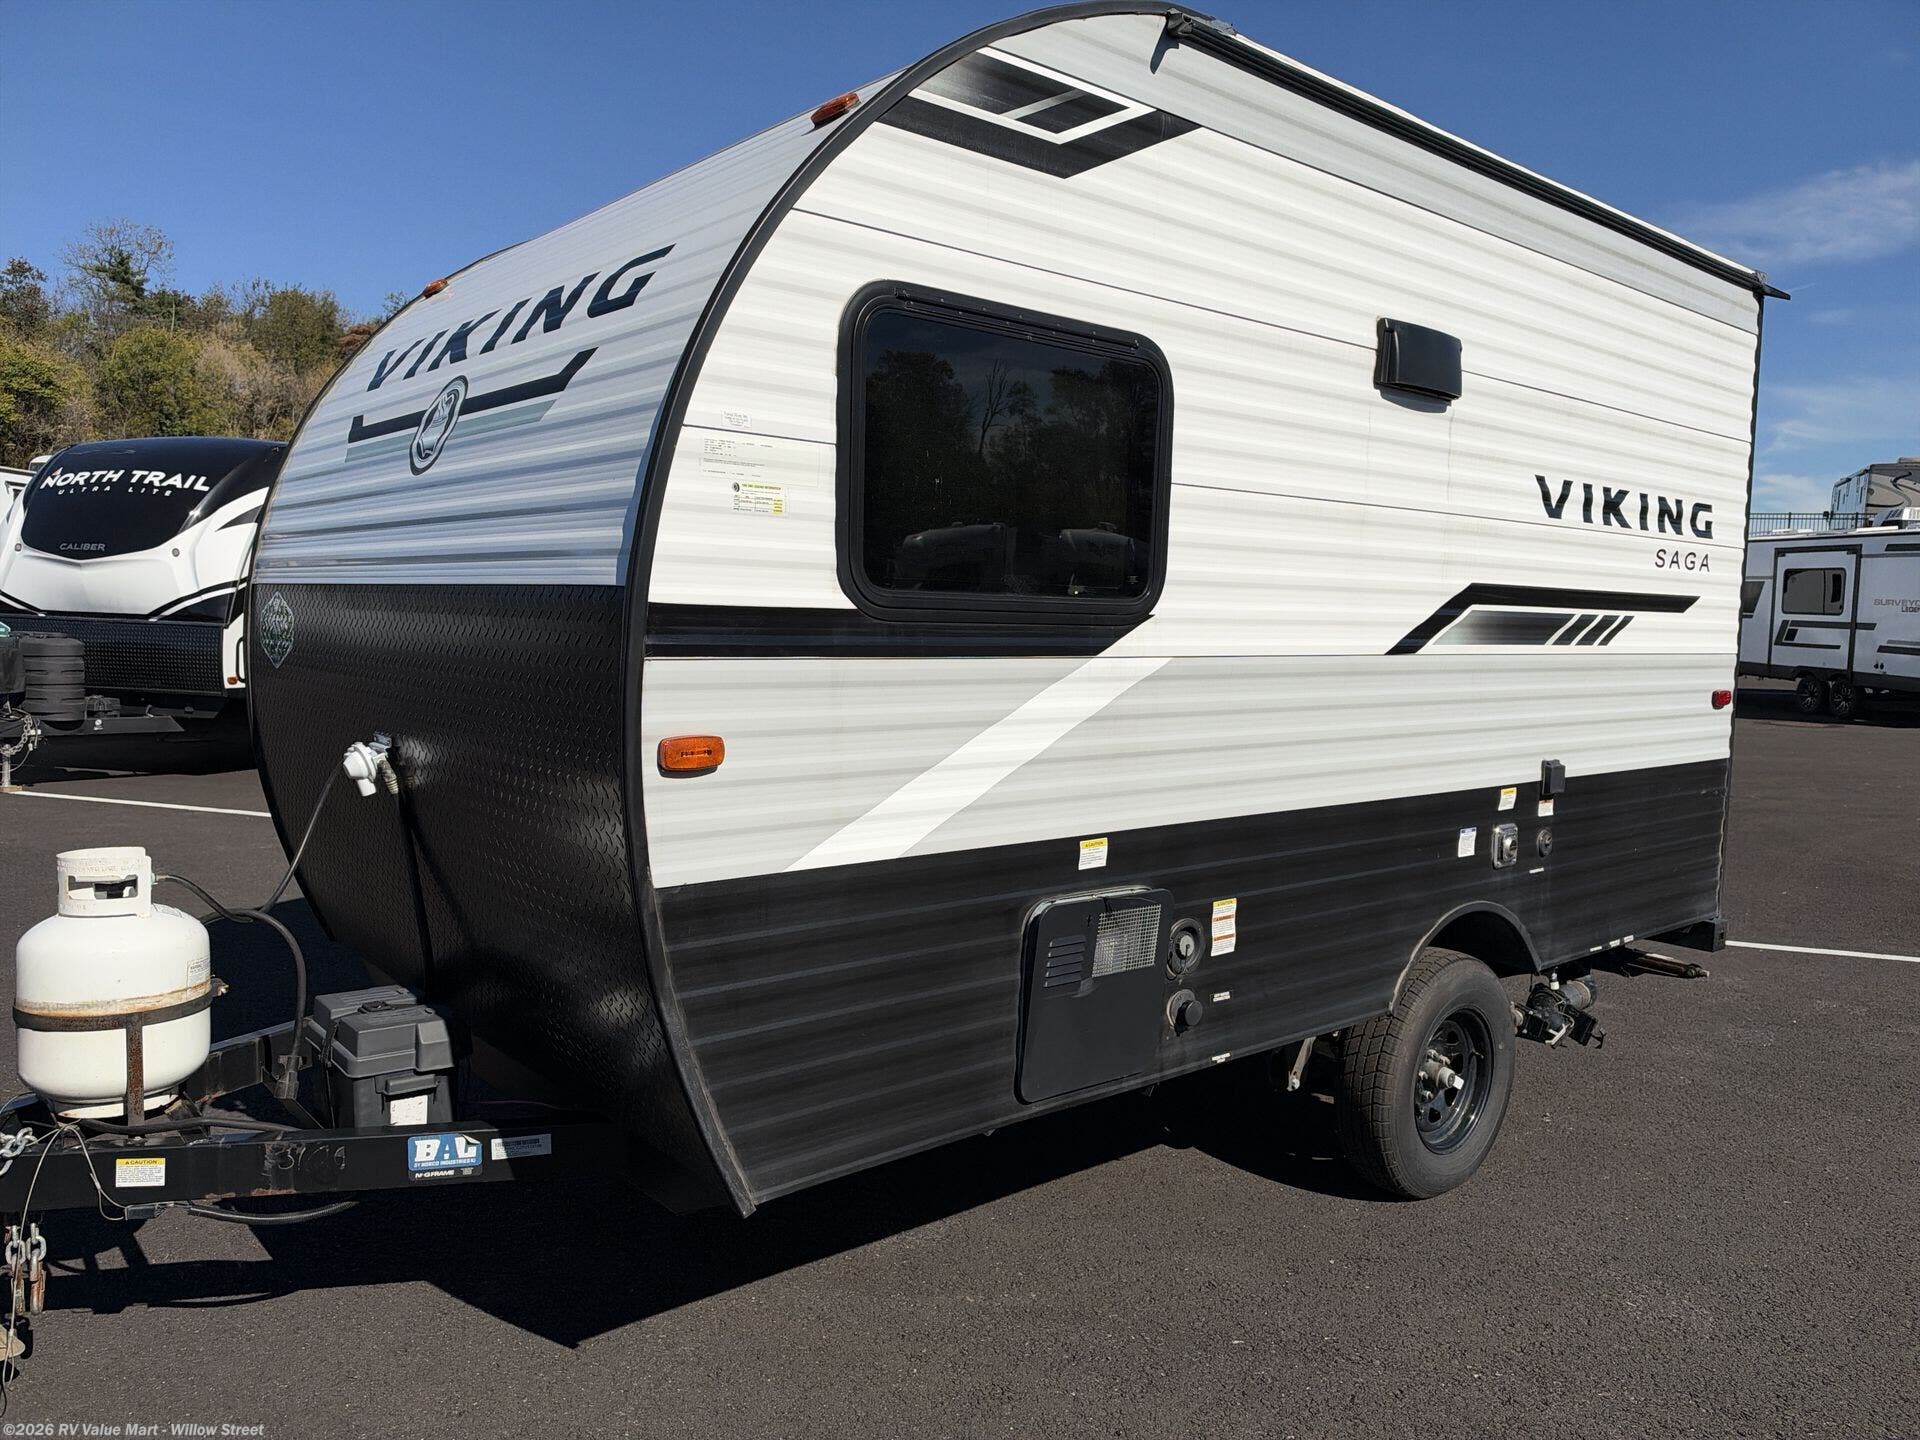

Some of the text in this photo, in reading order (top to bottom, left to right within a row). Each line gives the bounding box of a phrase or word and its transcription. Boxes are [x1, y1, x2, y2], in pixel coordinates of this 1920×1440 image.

[367, 243, 677, 392] VIKING
[40, 467, 210, 491] NORTH TRAIL
[58, 485, 172, 497] ULTRA LITE
[1535, 474, 1713, 539] VIKING
[59, 543, 106, 551] CALIBER
[1655, 548, 1710, 572] SAGA
[414, 1136, 477, 1162] BAL
